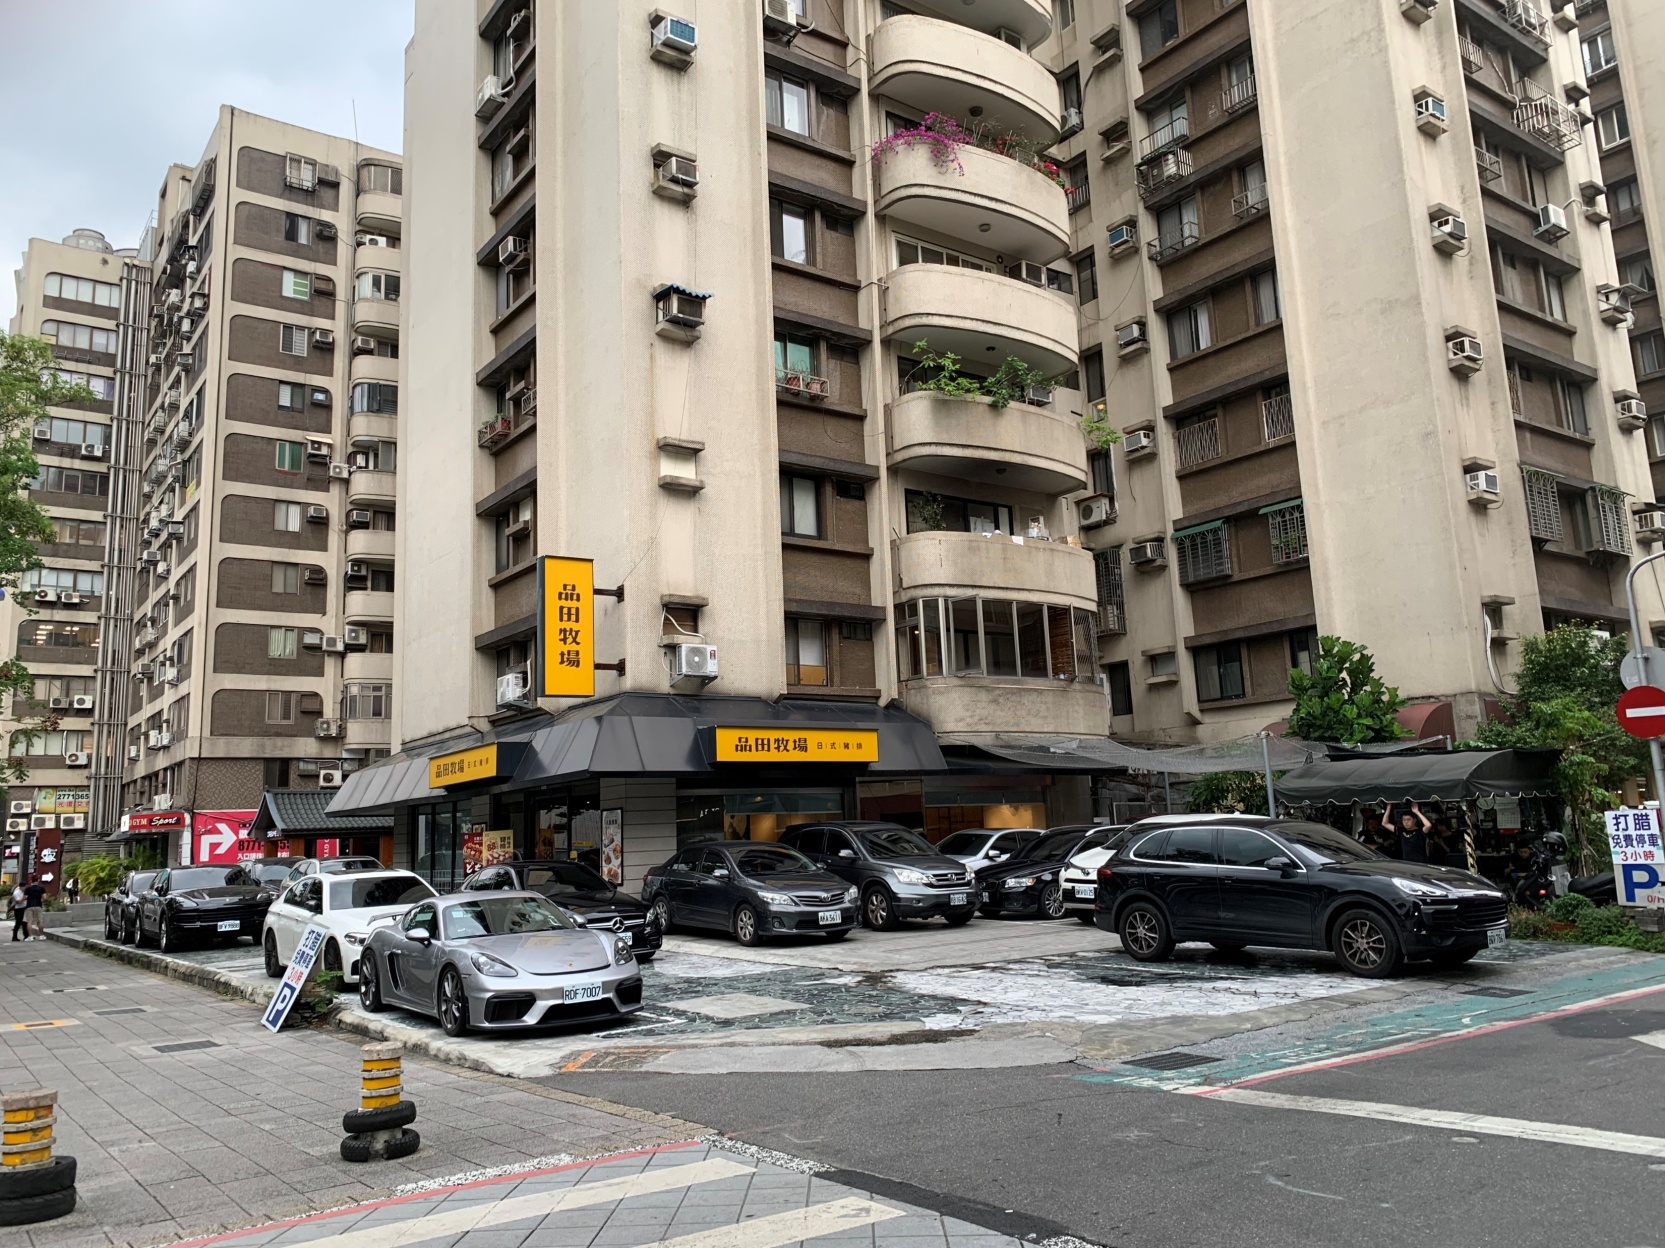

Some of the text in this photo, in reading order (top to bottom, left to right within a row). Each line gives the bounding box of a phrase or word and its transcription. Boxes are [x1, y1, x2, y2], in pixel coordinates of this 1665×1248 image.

[557, 583, 581, 669] 品田牧場
[735, 736, 808, 753] 品田牧場
[435, 758, 465, 779] 品田牧場
[151, 816, 178, 826] Sport
[1611, 833, 1660, 849] 免費停車
[1620, 850, 1655, 862] 3小時
[1621, 864, 1660, 903] P
[268, 987, 292, 1021] P
